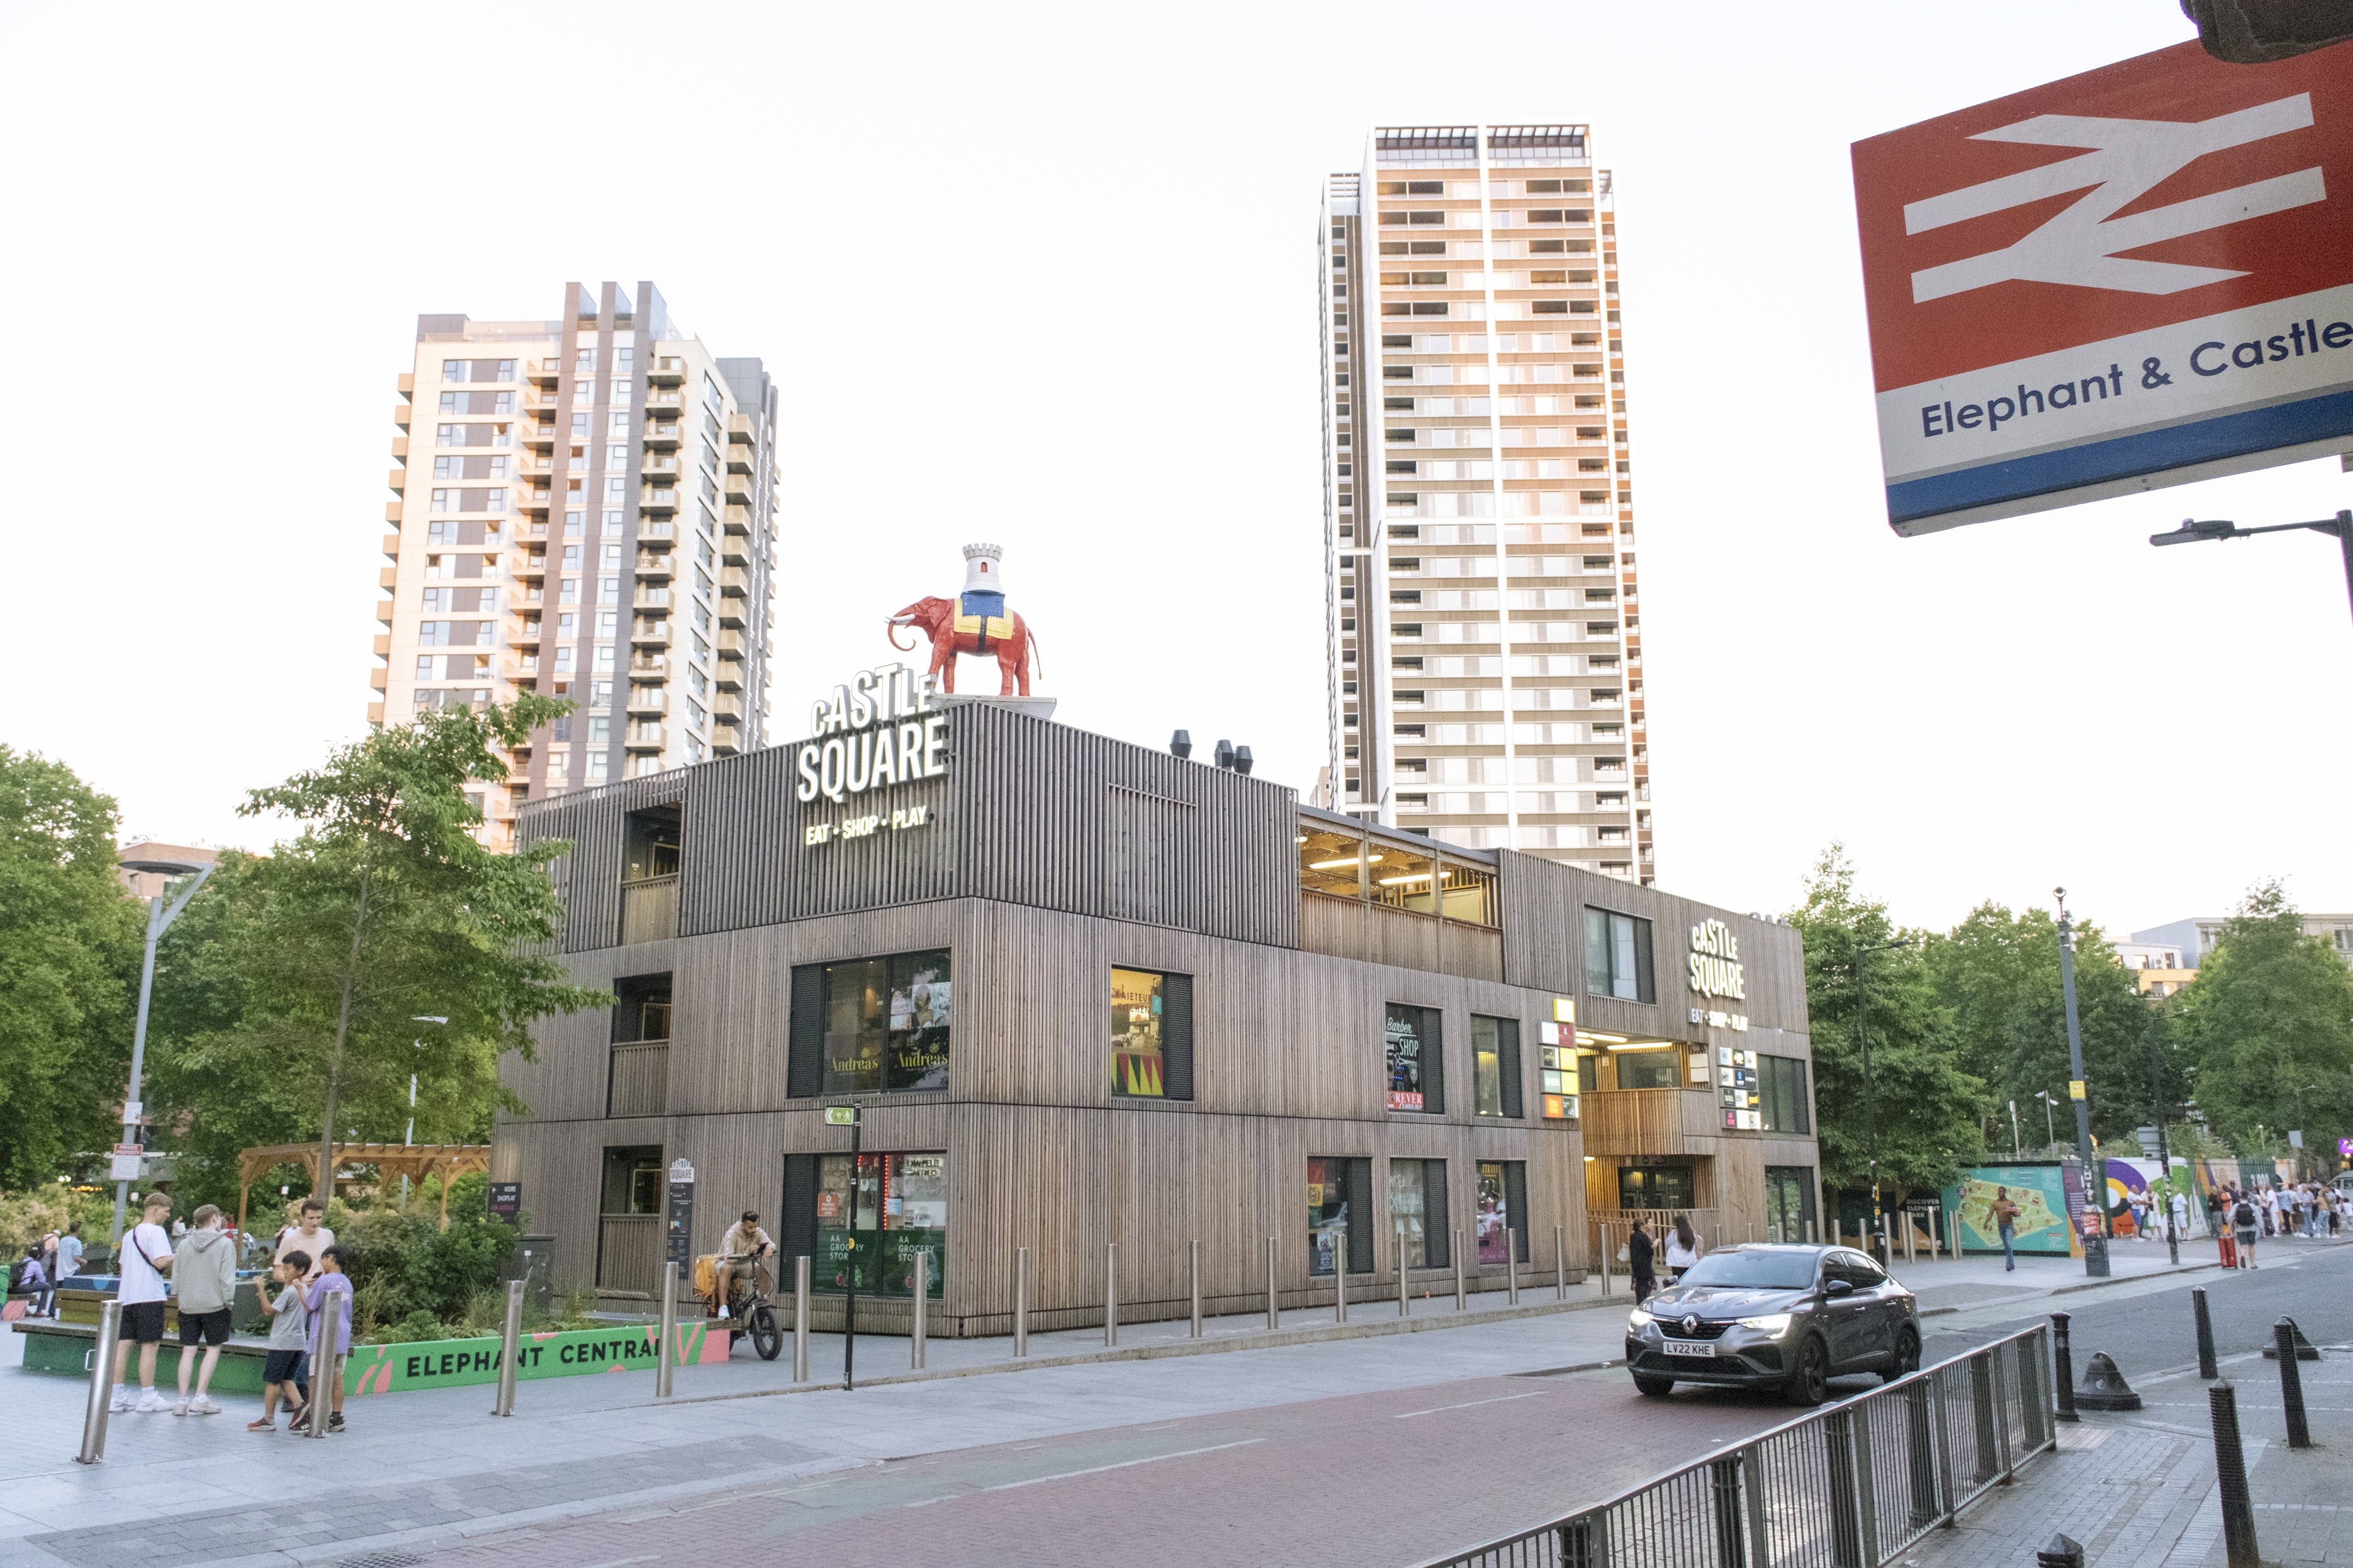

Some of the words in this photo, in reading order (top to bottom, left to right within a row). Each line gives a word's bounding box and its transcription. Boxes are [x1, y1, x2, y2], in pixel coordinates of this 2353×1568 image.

[1921, 363, 2124, 439] Elephant
[2141, 357, 2174, 390] &
[2190, 318, 2353, 377] Castle
[811, 663, 935, 738] CASTLE
[797, 716, 947, 804] SQUARE
[805, 823, 830, 846] EAT
[842, 815, 879, 839] SHOP
[891, 805, 928, 830] PLAY
[1691, 917, 1738, 960] CASTLE
[1689, 952, 1746, 1000] SQUARE
[1115, 990, 1152, 1003] KAIETEUR
[1117, 1002, 1150, 1014] KITCHEN
[1691, 1008, 1704, 1024] EAT
[1386, 1016, 1412, 1034] Barber
[1399, 1038, 1419, 1057] SHOP
[832, 1057, 879, 1072] Andreas
[899, 1051, 948, 1068] Andreas
[671, 1158, 691, 1168] CASTLE
[670, 1168, 692, 1180] SQUARE
[830, 1235, 840, 1243] AA
[899, 1235, 909, 1243] AA
[829, 1243, 864, 1252] GROCRY
[898, 1244, 935, 1253] GROCERY
[829, 1252, 848, 1260] STOR
[898, 1253, 913, 1262] STO
[1666, 1343, 1690, 1354] LV22
[1692, 1345, 1710, 1355] KHE
